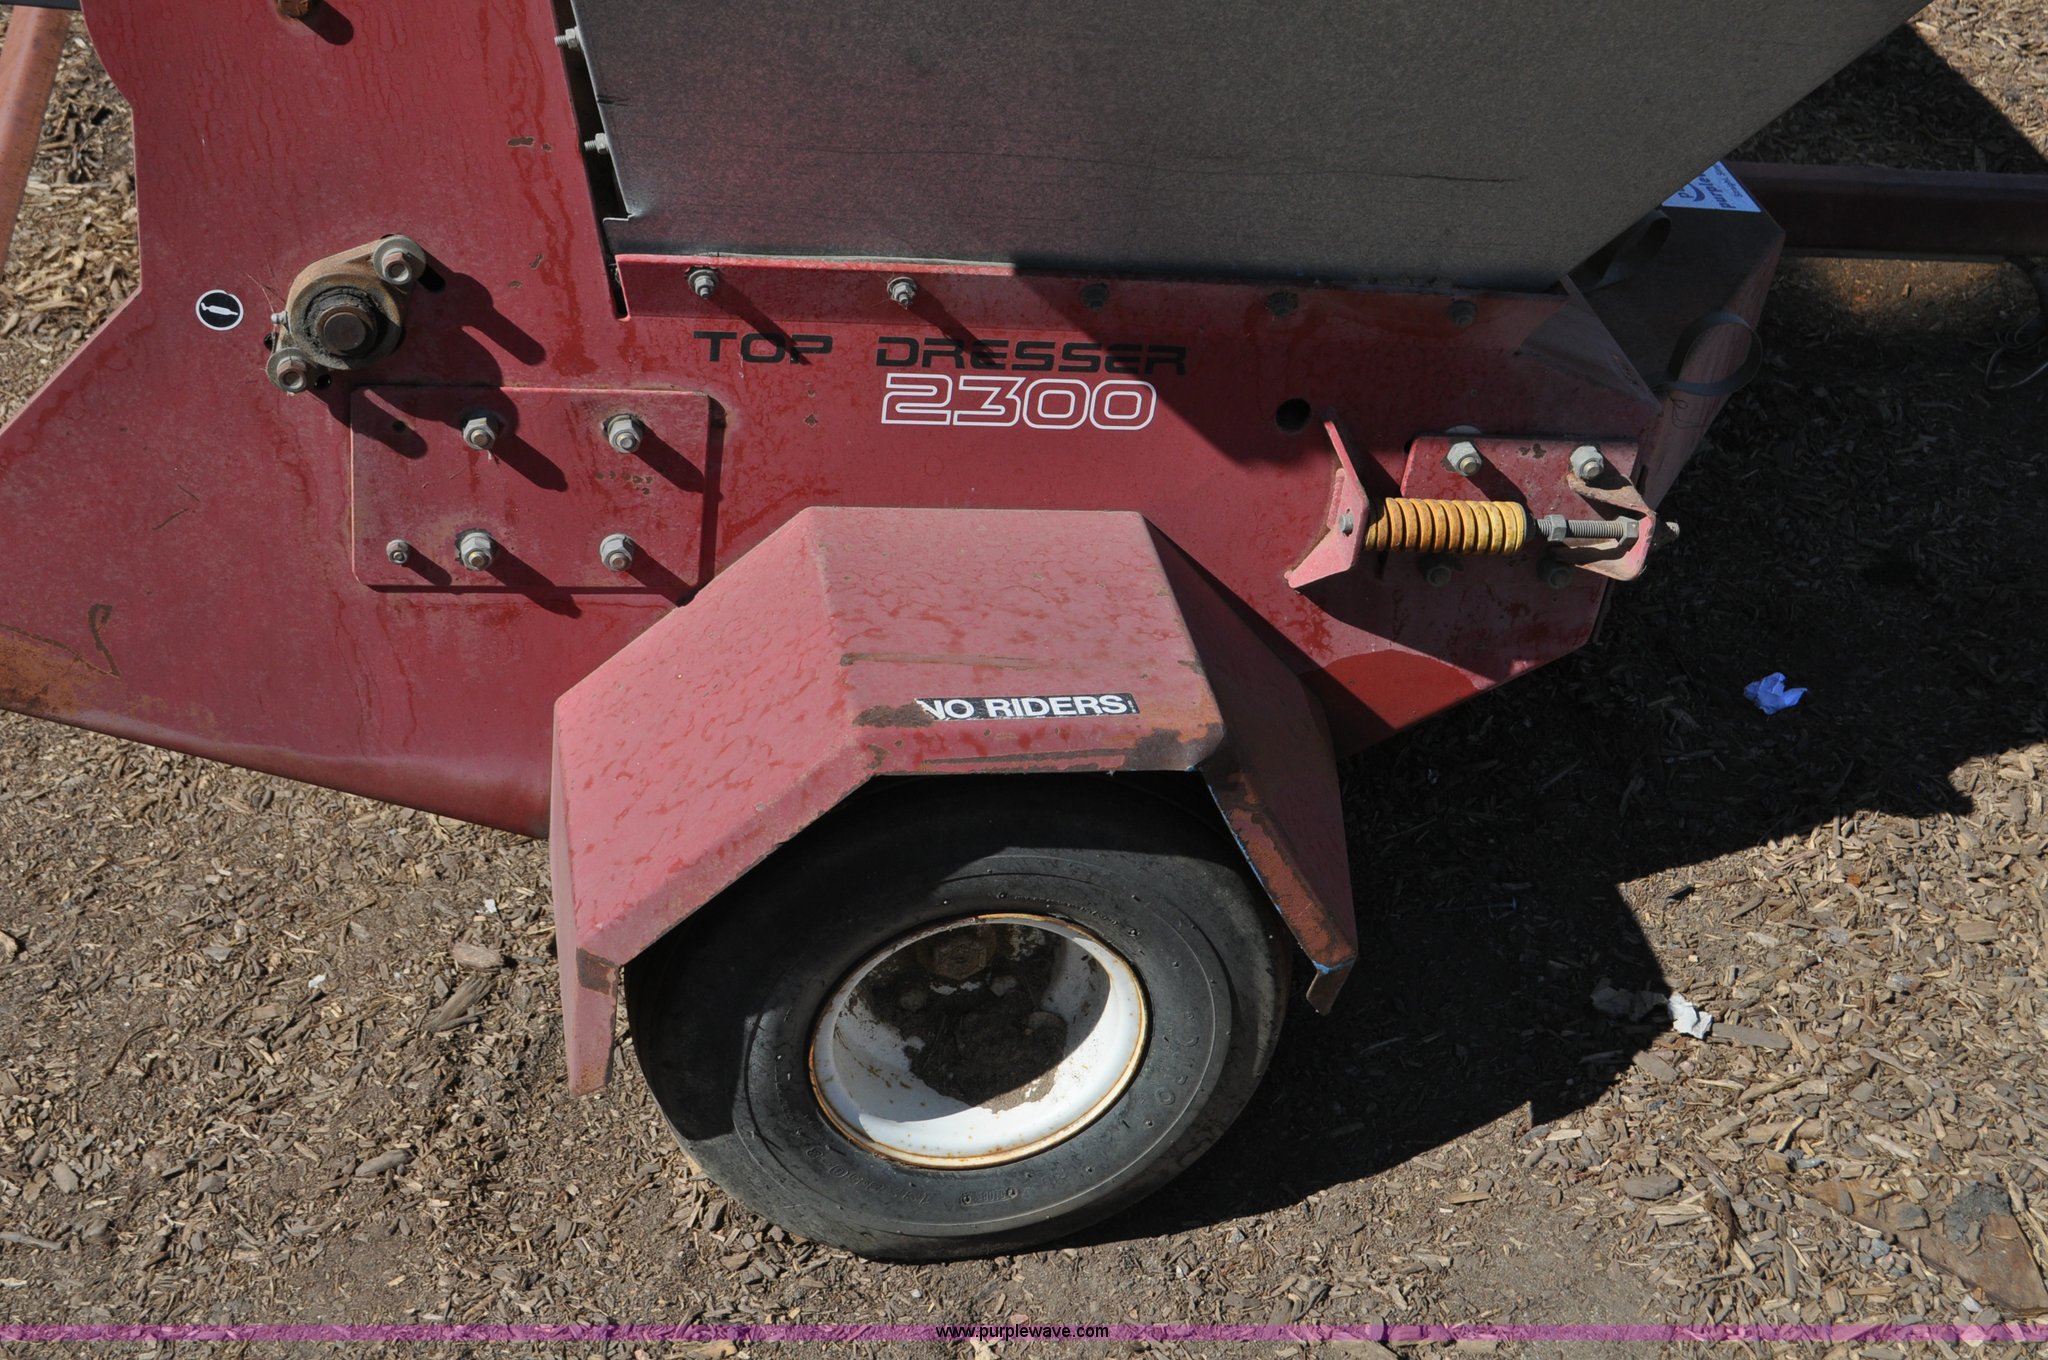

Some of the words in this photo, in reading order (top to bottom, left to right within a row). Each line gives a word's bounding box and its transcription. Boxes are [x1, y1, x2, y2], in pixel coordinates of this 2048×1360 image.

[694, 331, 834, 364] TOP
[876, 336, 1187, 376] DRESSER
[881, 372, 1158, 430] 2300
